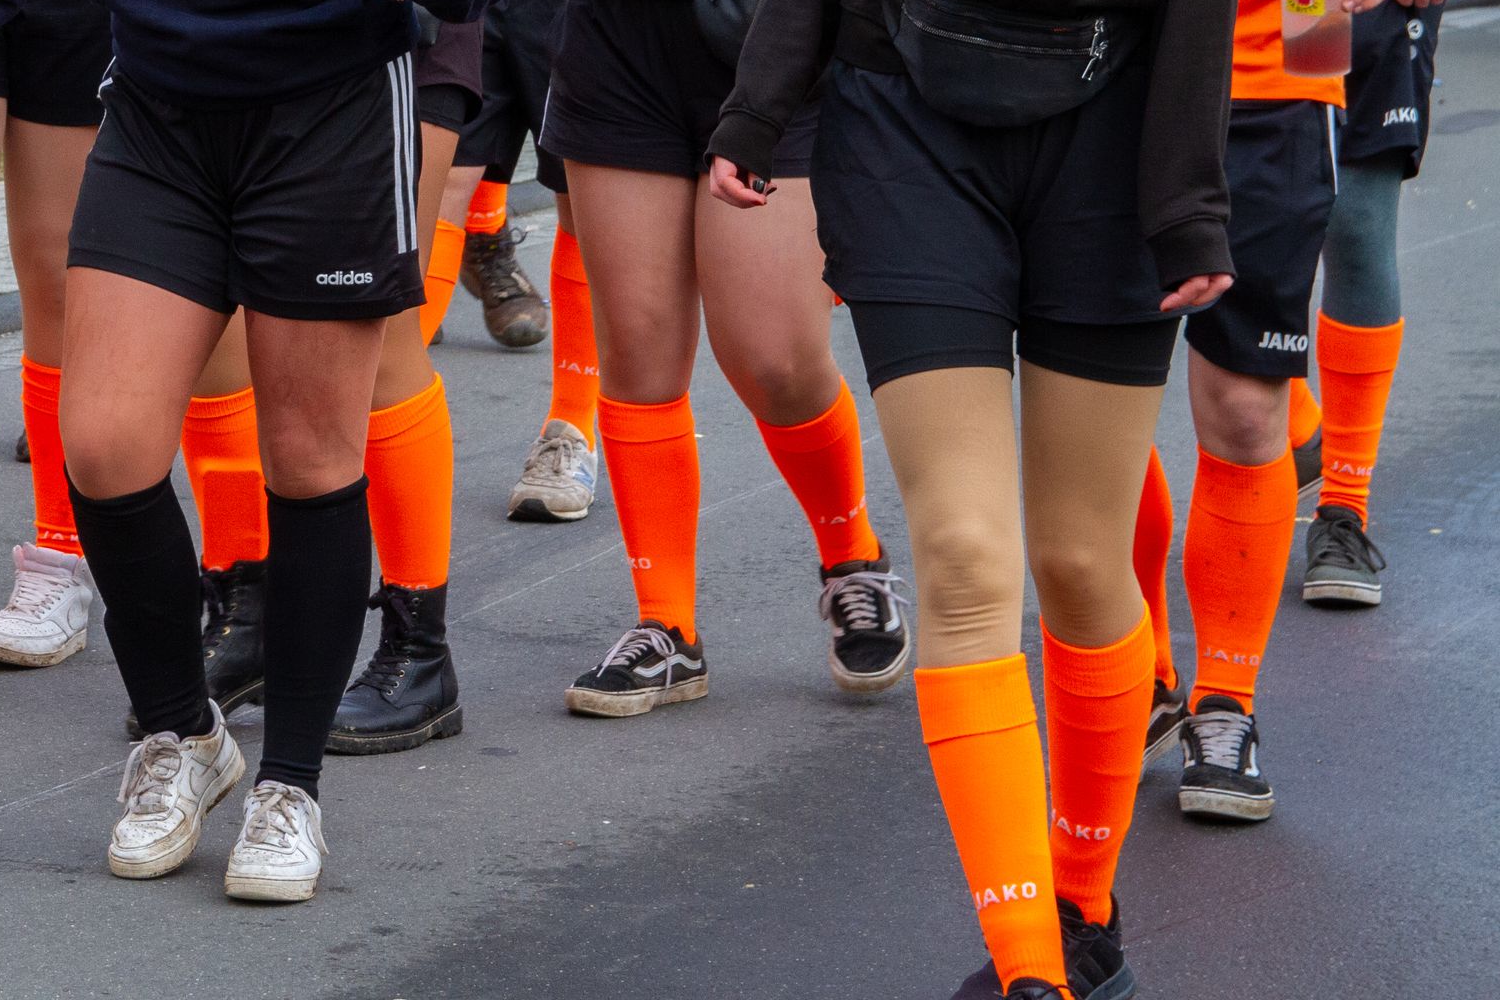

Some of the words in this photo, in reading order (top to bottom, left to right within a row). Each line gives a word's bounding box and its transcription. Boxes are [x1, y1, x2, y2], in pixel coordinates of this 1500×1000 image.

[1382, 106, 1419, 128] JAKO
[316, 270, 374, 285] adidas
[1257, 331, 1309, 353] JAKO
[975, 881, 1038, 912] JAKO
